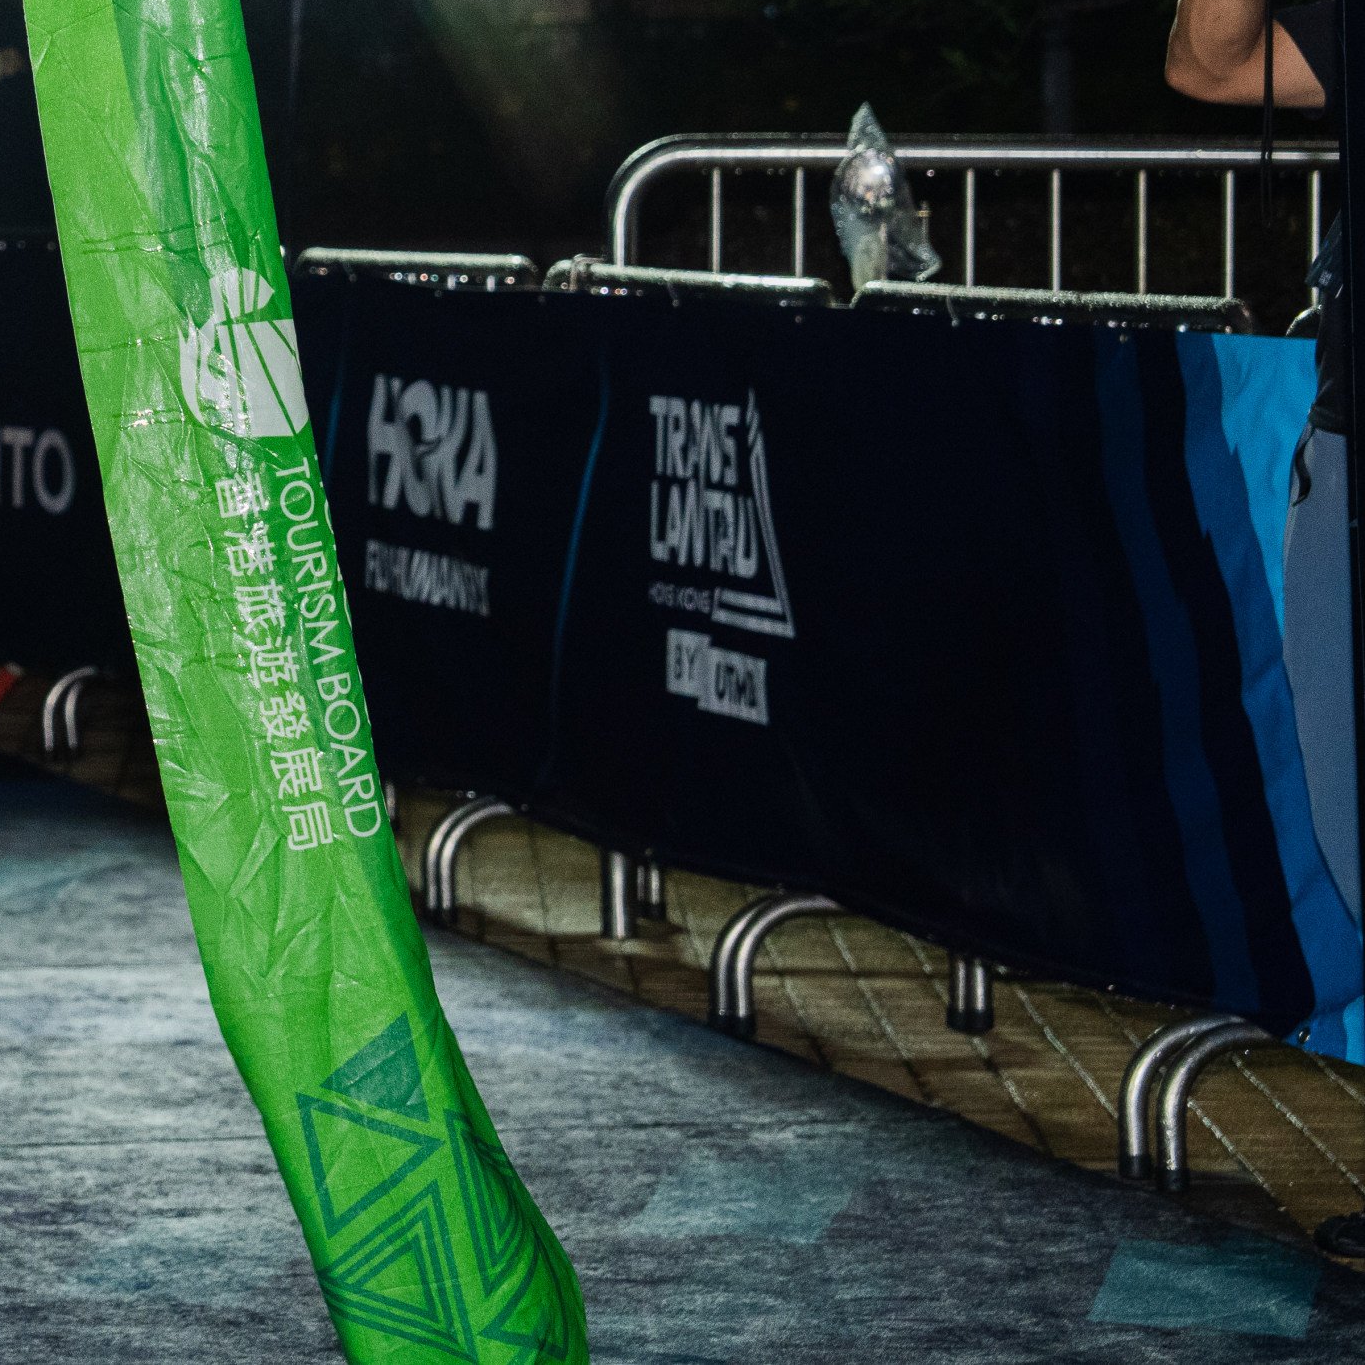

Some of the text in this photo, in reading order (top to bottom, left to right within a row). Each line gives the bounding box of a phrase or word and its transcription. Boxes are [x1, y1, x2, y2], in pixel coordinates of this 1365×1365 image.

[650, 395, 739, 485] TRANS
[650, 479, 759, 579] LANTAU
[215, 468, 334, 852] 香港旅遊發展局
[275, 456, 346, 664] TOURISM
[316, 669, 381, 840] BOARD
